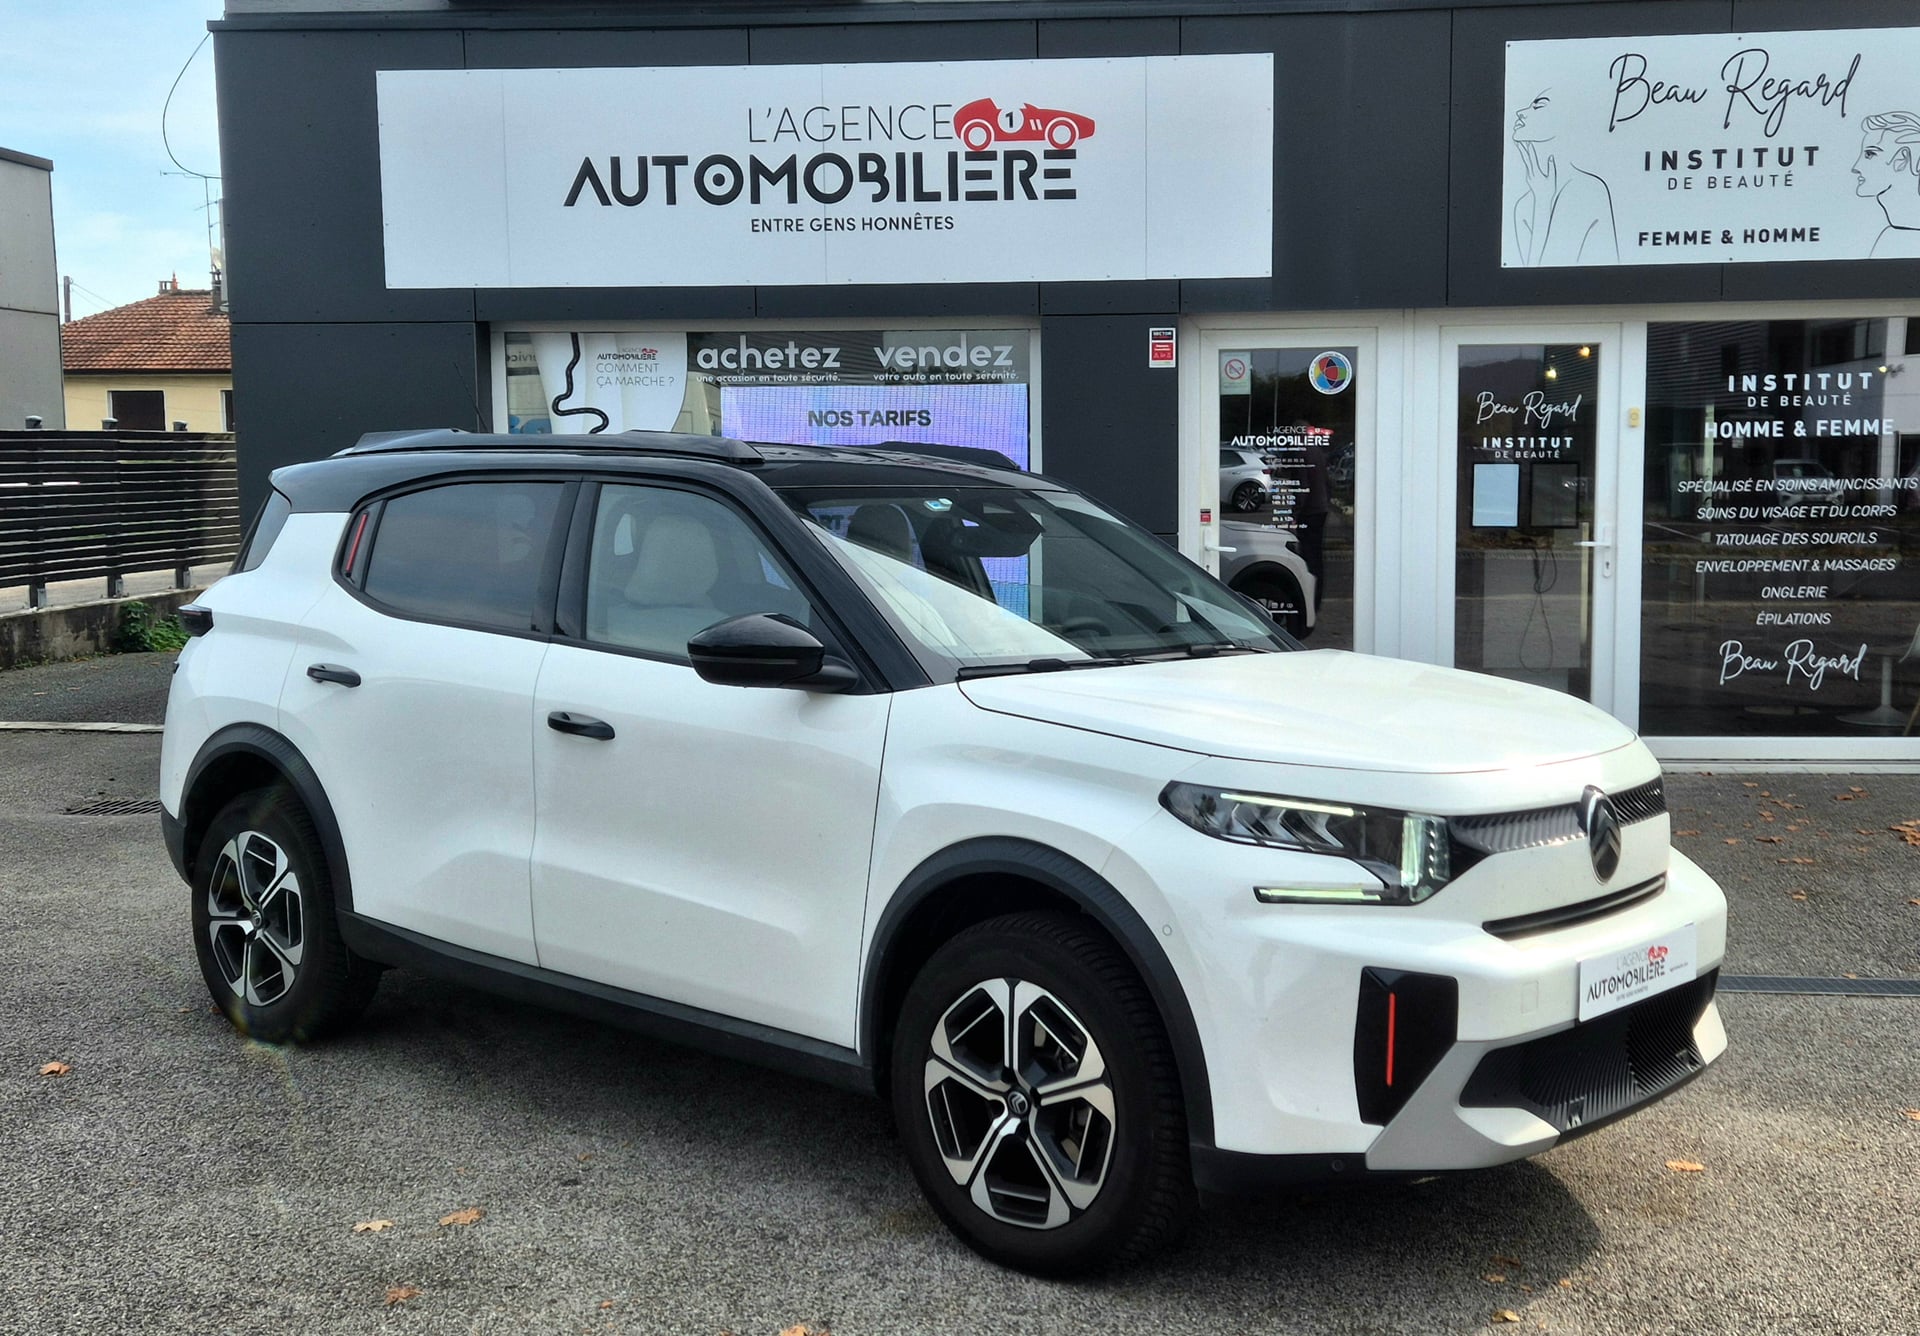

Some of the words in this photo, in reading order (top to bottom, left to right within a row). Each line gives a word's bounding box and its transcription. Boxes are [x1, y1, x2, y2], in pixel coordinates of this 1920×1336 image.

[1609, 53, 1708, 133] Beau
[1720, 48, 1862, 138] Regard
[749, 104, 953, 143] L'AGENCE
[1644, 146, 1820, 172] INSTITUT
[1667, 176, 1693, 190] DE
[1707, 169, 1794, 189] BEAUTÉ
[751, 218, 805, 233] ENTRE
[809, 217, 856, 232] GENS
[861, 212, 954, 231] HONNÊTES
[1638, 230, 1712, 247] FEMME
[1720, 229, 1735, 245] &
[1743, 227, 1820, 244] HOMME
[696, 335, 841, 369] achetez
[873, 334, 1013, 368] vendez
[595, 362, 660, 374] COMMENT
[873, 373, 900, 381] votre
[903, 372, 927, 381] auto
[929, 373, 942, 381] en
[945, 372, 972, 380] toute
[596, 376, 615, 388] ÇA
[615, 376, 665, 387] MARCHE
[668, 376, 675, 387] ?
[696, 374, 713, 383] une
[716, 373, 756, 383] occasion
[758, 374, 770, 382] en
[773, 374, 798, 382] toute
[1727, 372, 1873, 392] INSTITUT
[1747, 396, 1769, 407] DE
[1780, 392, 1852, 407] BEAUTÉ
[1476, 391, 1519, 425] Beau
[1522, 390, 1583, 429] Regard
[807, 410, 855, 428] NOS
[856, 409, 932, 427] TARIFS
[1704, 421, 1784, 439] HOMME
[1793, 420, 1807, 437] &
[1816, 418, 1894, 437] FEMME
[1482, 436, 1573, 449] INSTITUT
[1494, 450, 1509, 459] DE
[1515, 449, 1561, 459] BEAUTÉ
[1677, 477, 1753, 493] SPÉCIALISÉ
[1755, 479, 1775, 492] EN
[1776, 478, 1818, 492] SOINS
[1820, 477, 1919, 491] AMINCISSANTS
[1696, 506, 1737, 520] SOINS
[1739, 506, 1760, 519] DU
[1761, 505, 1807, 519] VISAGE
[1810, 505, 1828, 518] ET
[1828, 505, 1850, 518] DU
[1851, 504, 1898, 518] CORPS
[1715, 532, 1780, 546] TATOUAGE
[1781, 532, 1809, 545] DES
[1810, 531, 1878, 545] SOURCILS
[1695, 559, 1810, 573] ENVELOPPEMENT
[1811, 559, 1821, 571] &
[1823, 558, 1897, 572] MASSAGES
[1761, 586, 1829, 599] ONGLERIE
[1756, 610, 1832, 625] ÉPILATIONS
[1719, 639, 1778, 685] Beau
[1784, 638, 1868, 691] Regard
